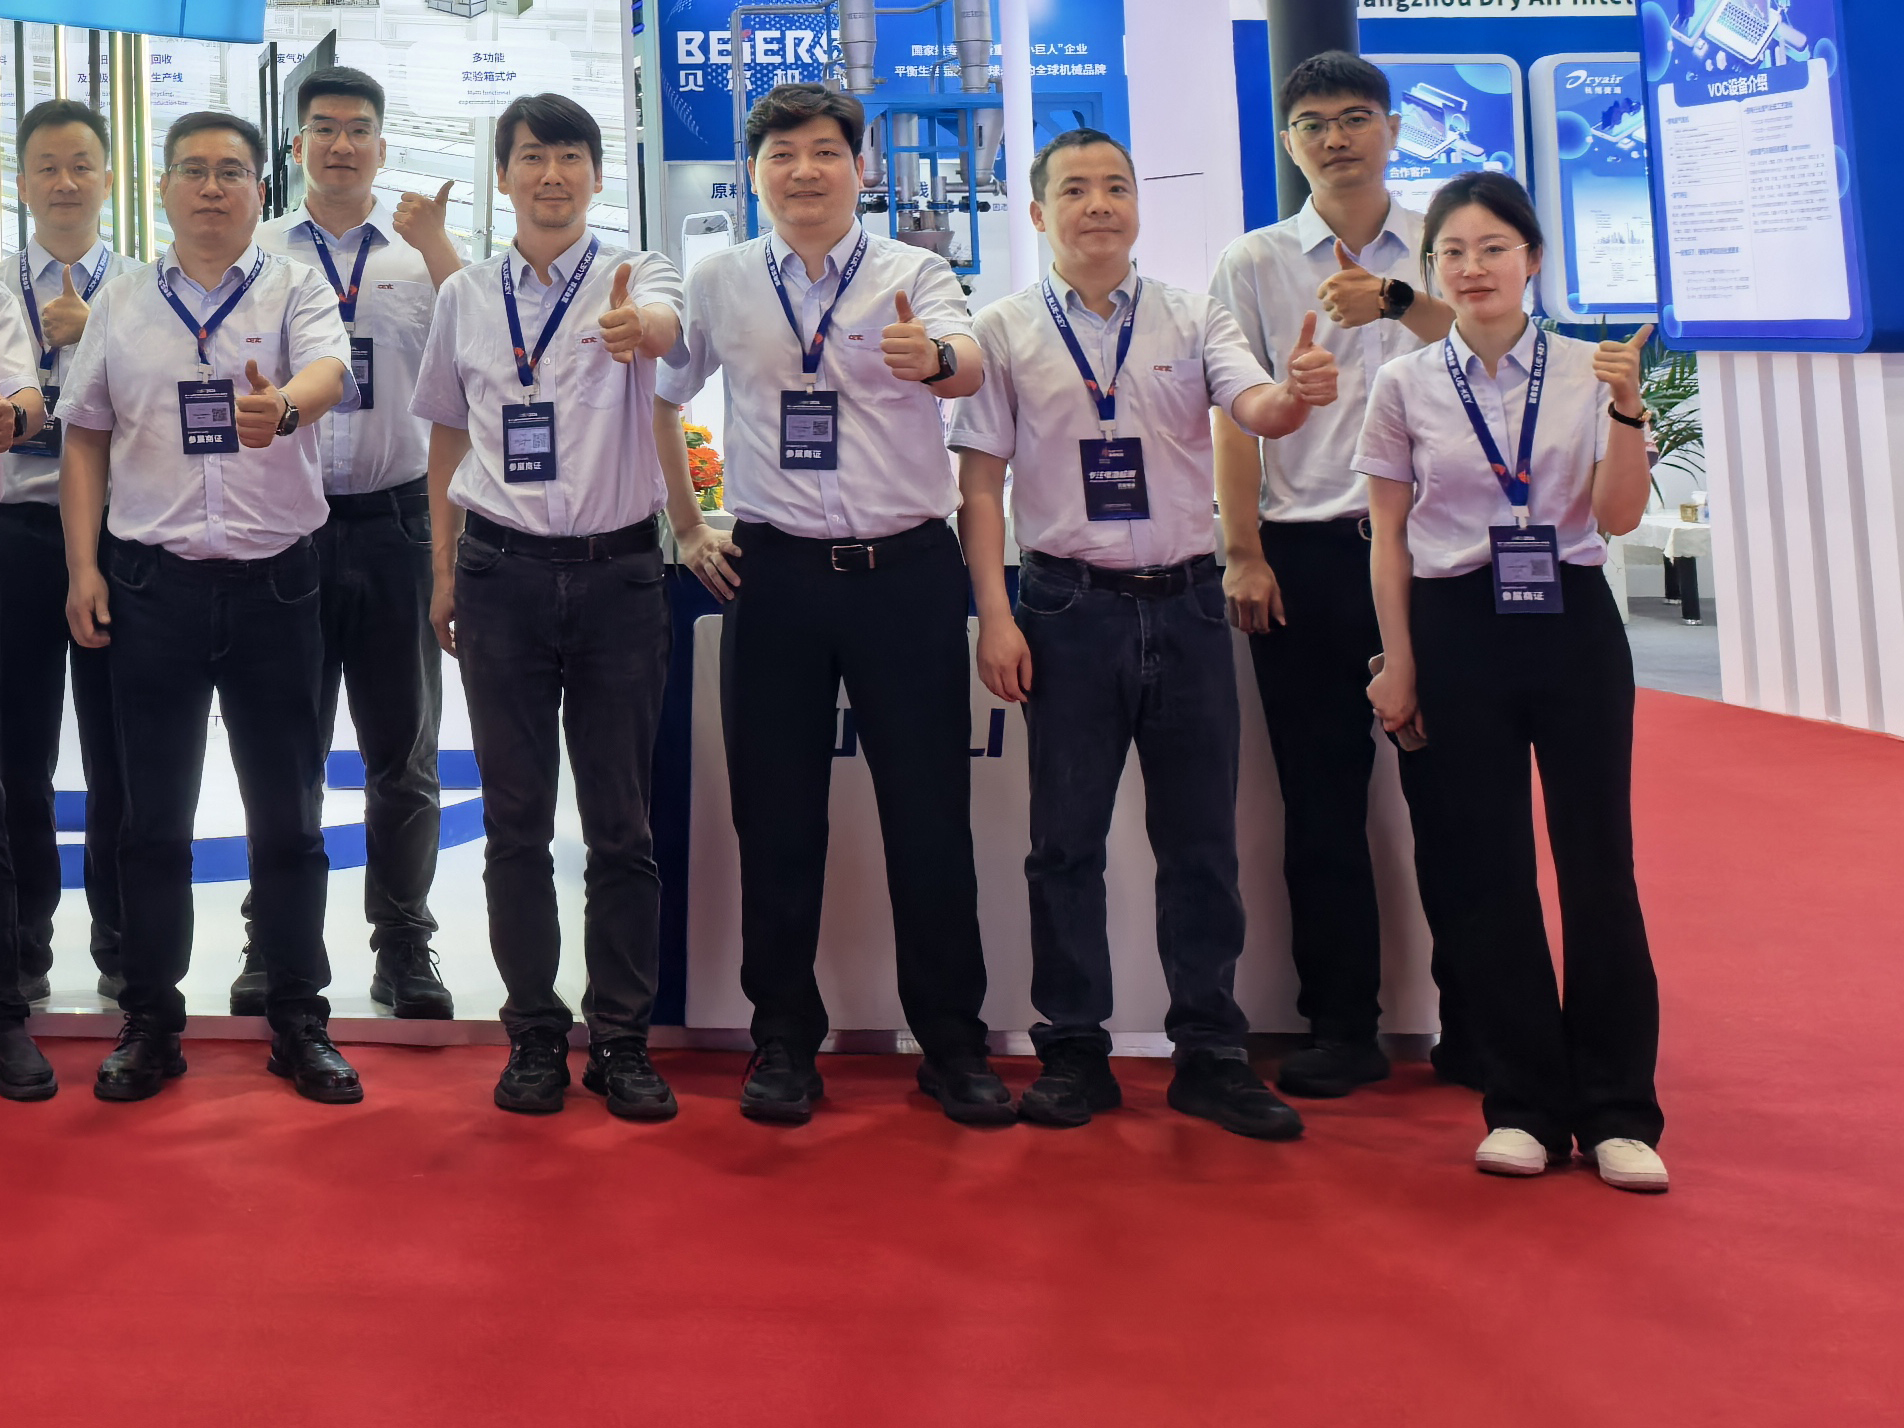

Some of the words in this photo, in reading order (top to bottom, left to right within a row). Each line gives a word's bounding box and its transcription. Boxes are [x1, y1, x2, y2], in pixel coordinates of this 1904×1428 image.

[472, 52, 506, 63] 多功能
[462, 70, 517, 82] 实验箱式炉
